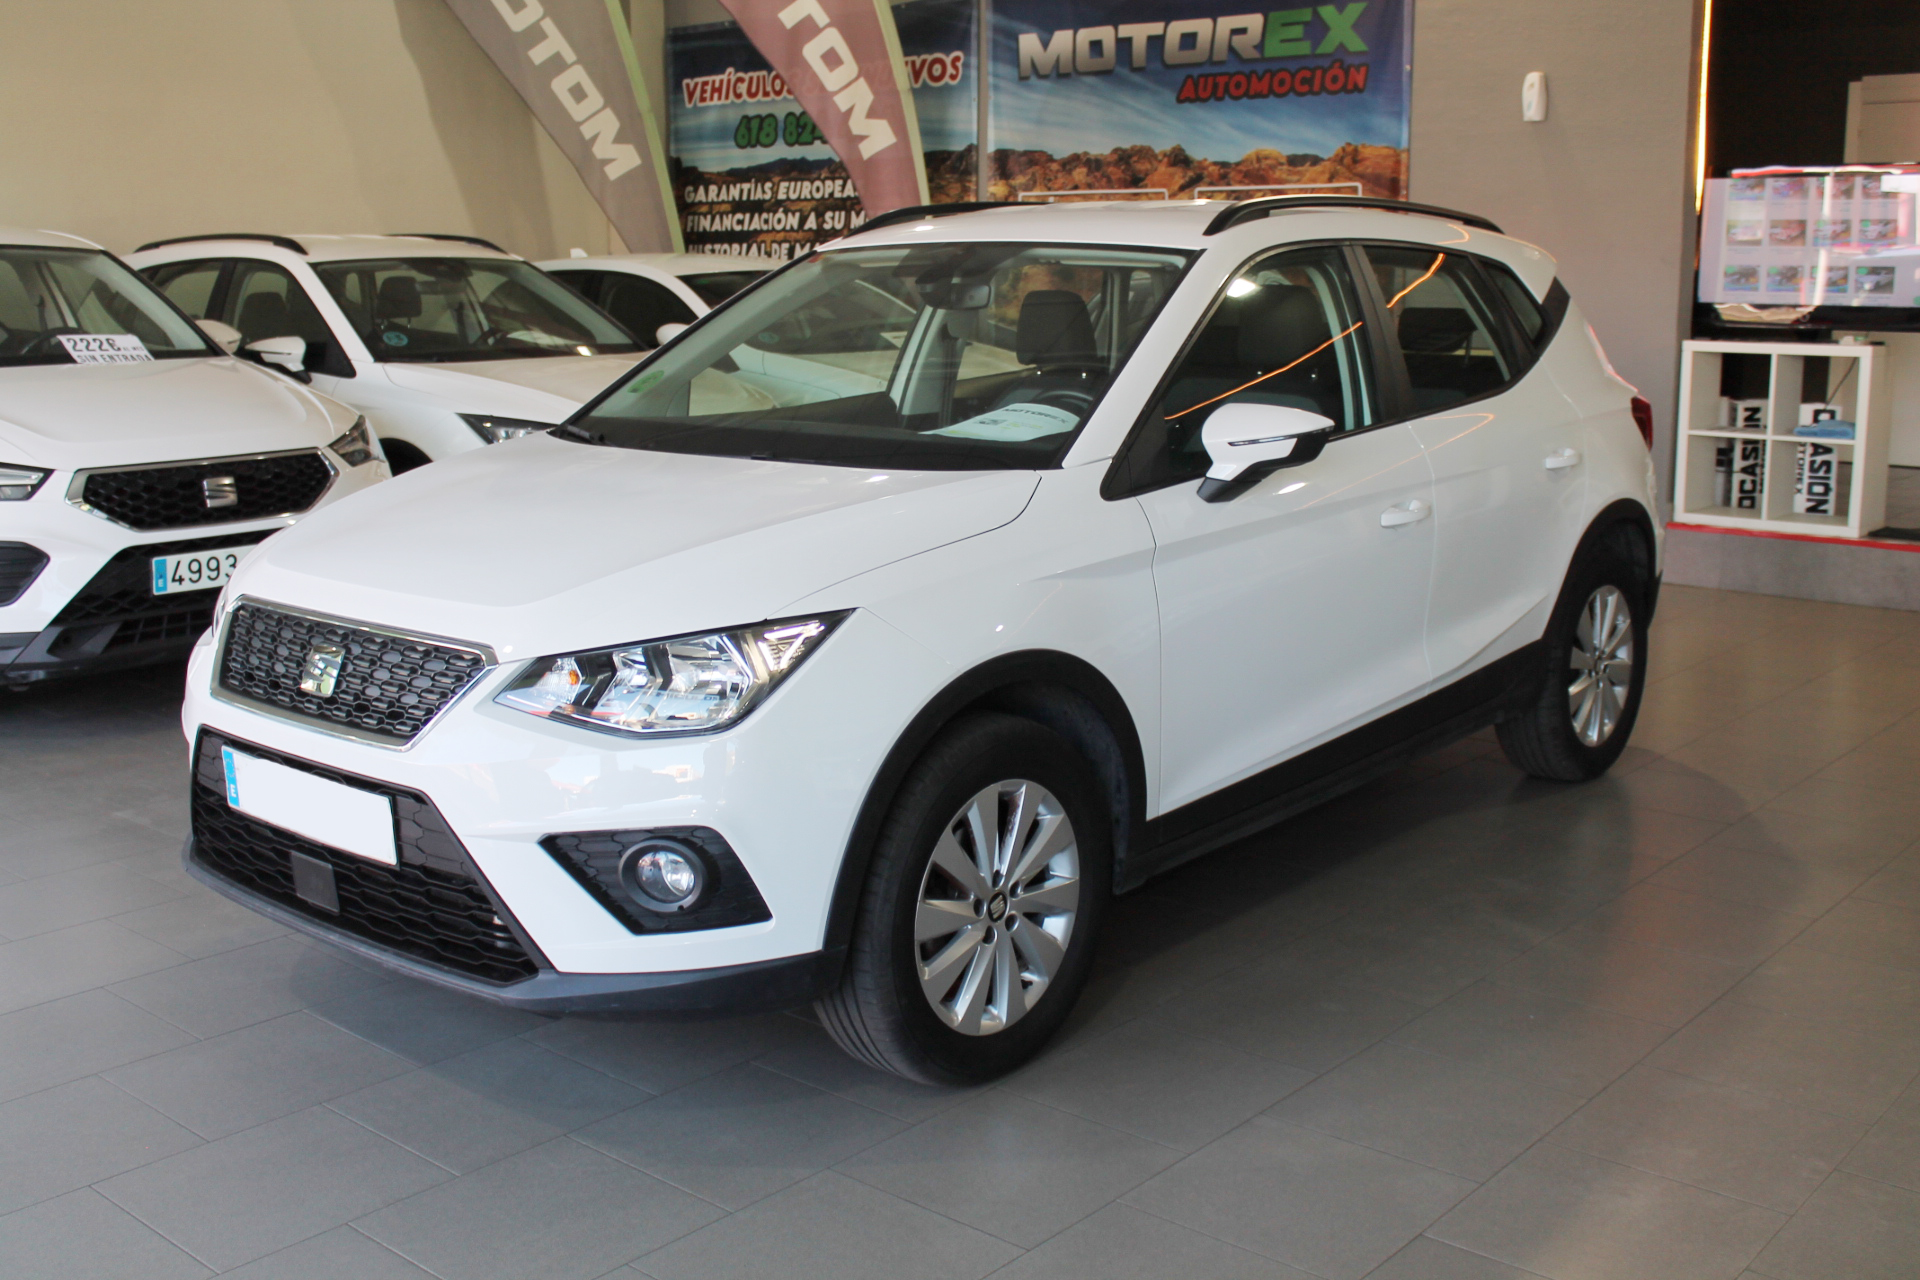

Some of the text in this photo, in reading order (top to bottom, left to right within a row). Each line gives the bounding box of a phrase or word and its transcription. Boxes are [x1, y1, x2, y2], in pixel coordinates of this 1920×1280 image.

[1018, 2, 1369, 79] MOTOREX
[1177, 60, 1369, 102] AUTOMOCIÓN
[734, 114, 778, 149] 618
[684, 178, 859, 203] GARANTÍAS EUROPEA
[686, 207, 869, 233] FINANCIACIÓN A SU M
[771, 242, 789, 261] DE
[76, 354, 154, 363] SIN ENTRADA
[1738, 407, 1762, 509] OCASIN
[171, 554, 237, 586] 4993
[230, 783, 237, 798] E
